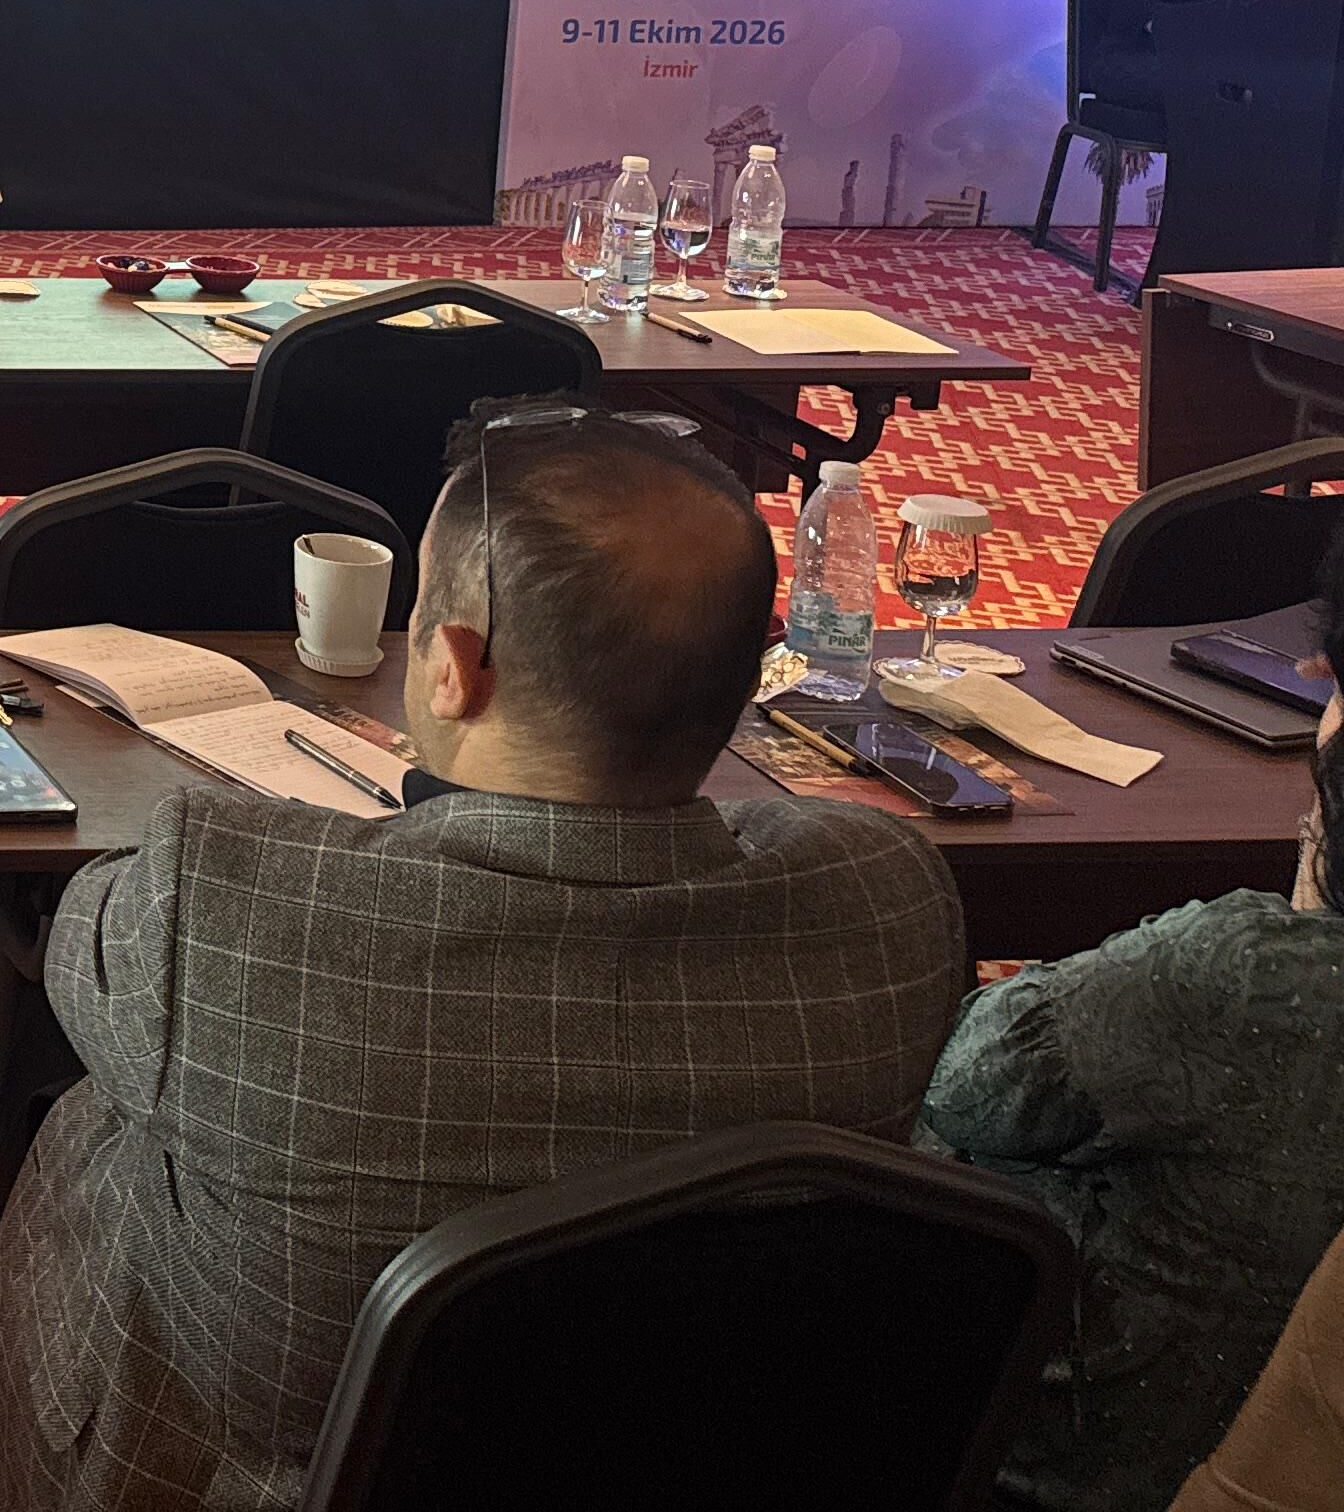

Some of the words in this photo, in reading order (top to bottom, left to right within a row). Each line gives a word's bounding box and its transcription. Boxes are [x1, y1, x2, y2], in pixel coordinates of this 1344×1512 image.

[562, 19, 620, 44] 9-11
[629, 19, 702, 45] Ekim
[709, 20, 785, 45] 2026
[643, 55, 699, 79] İzmir
